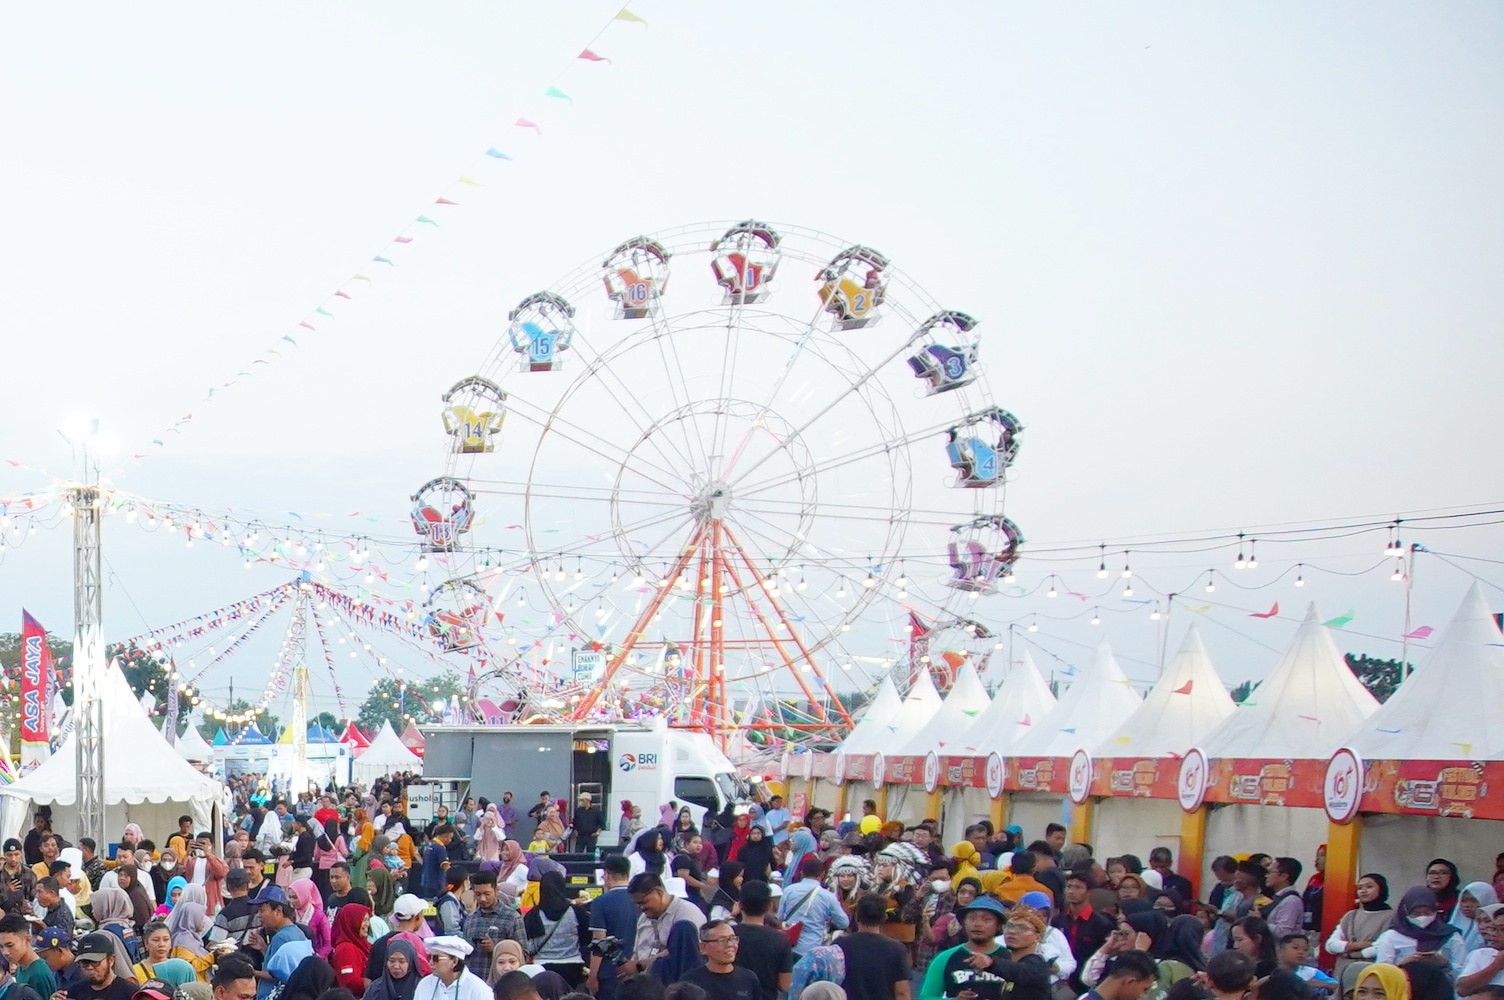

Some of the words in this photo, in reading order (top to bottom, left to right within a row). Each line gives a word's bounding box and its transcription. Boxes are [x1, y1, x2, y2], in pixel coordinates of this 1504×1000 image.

[746, 268, 754, 286] 1
[630, 284, 646, 302] 16
[854, 294, 865, 311] 2
[533, 337, 550, 355] 15
[947, 356, 962, 376] 3
[465, 422, 482, 438] 14
[983, 456, 994, 470] 4
[25, 636, 42, 685] JAYA
[25, 689, 40, 732] ASA
[638, 753, 658, 765] BRI
